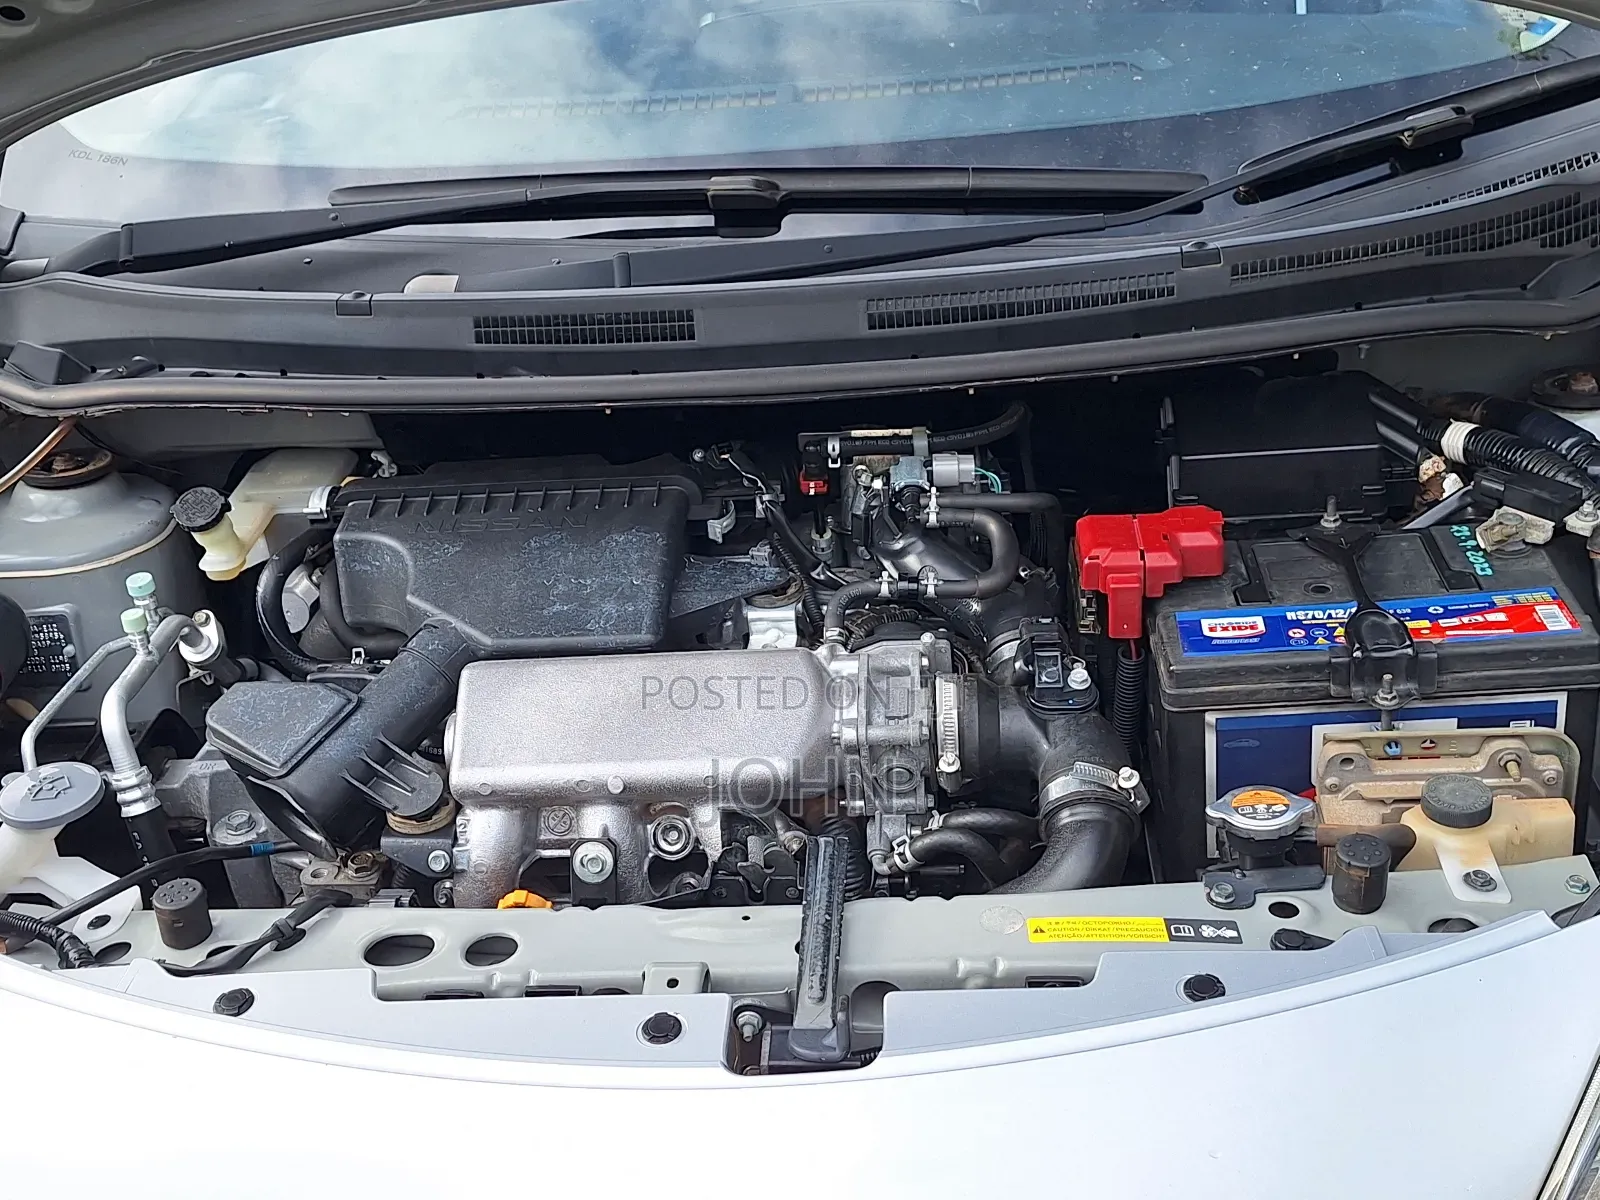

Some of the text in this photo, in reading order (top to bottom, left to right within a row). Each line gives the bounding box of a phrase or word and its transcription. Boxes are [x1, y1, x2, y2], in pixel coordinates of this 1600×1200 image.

[68, 149, 128, 166] KDL 186N
[408, 504, 588, 534] NISSAN
[1207, 624, 1259, 632] EXIDE
